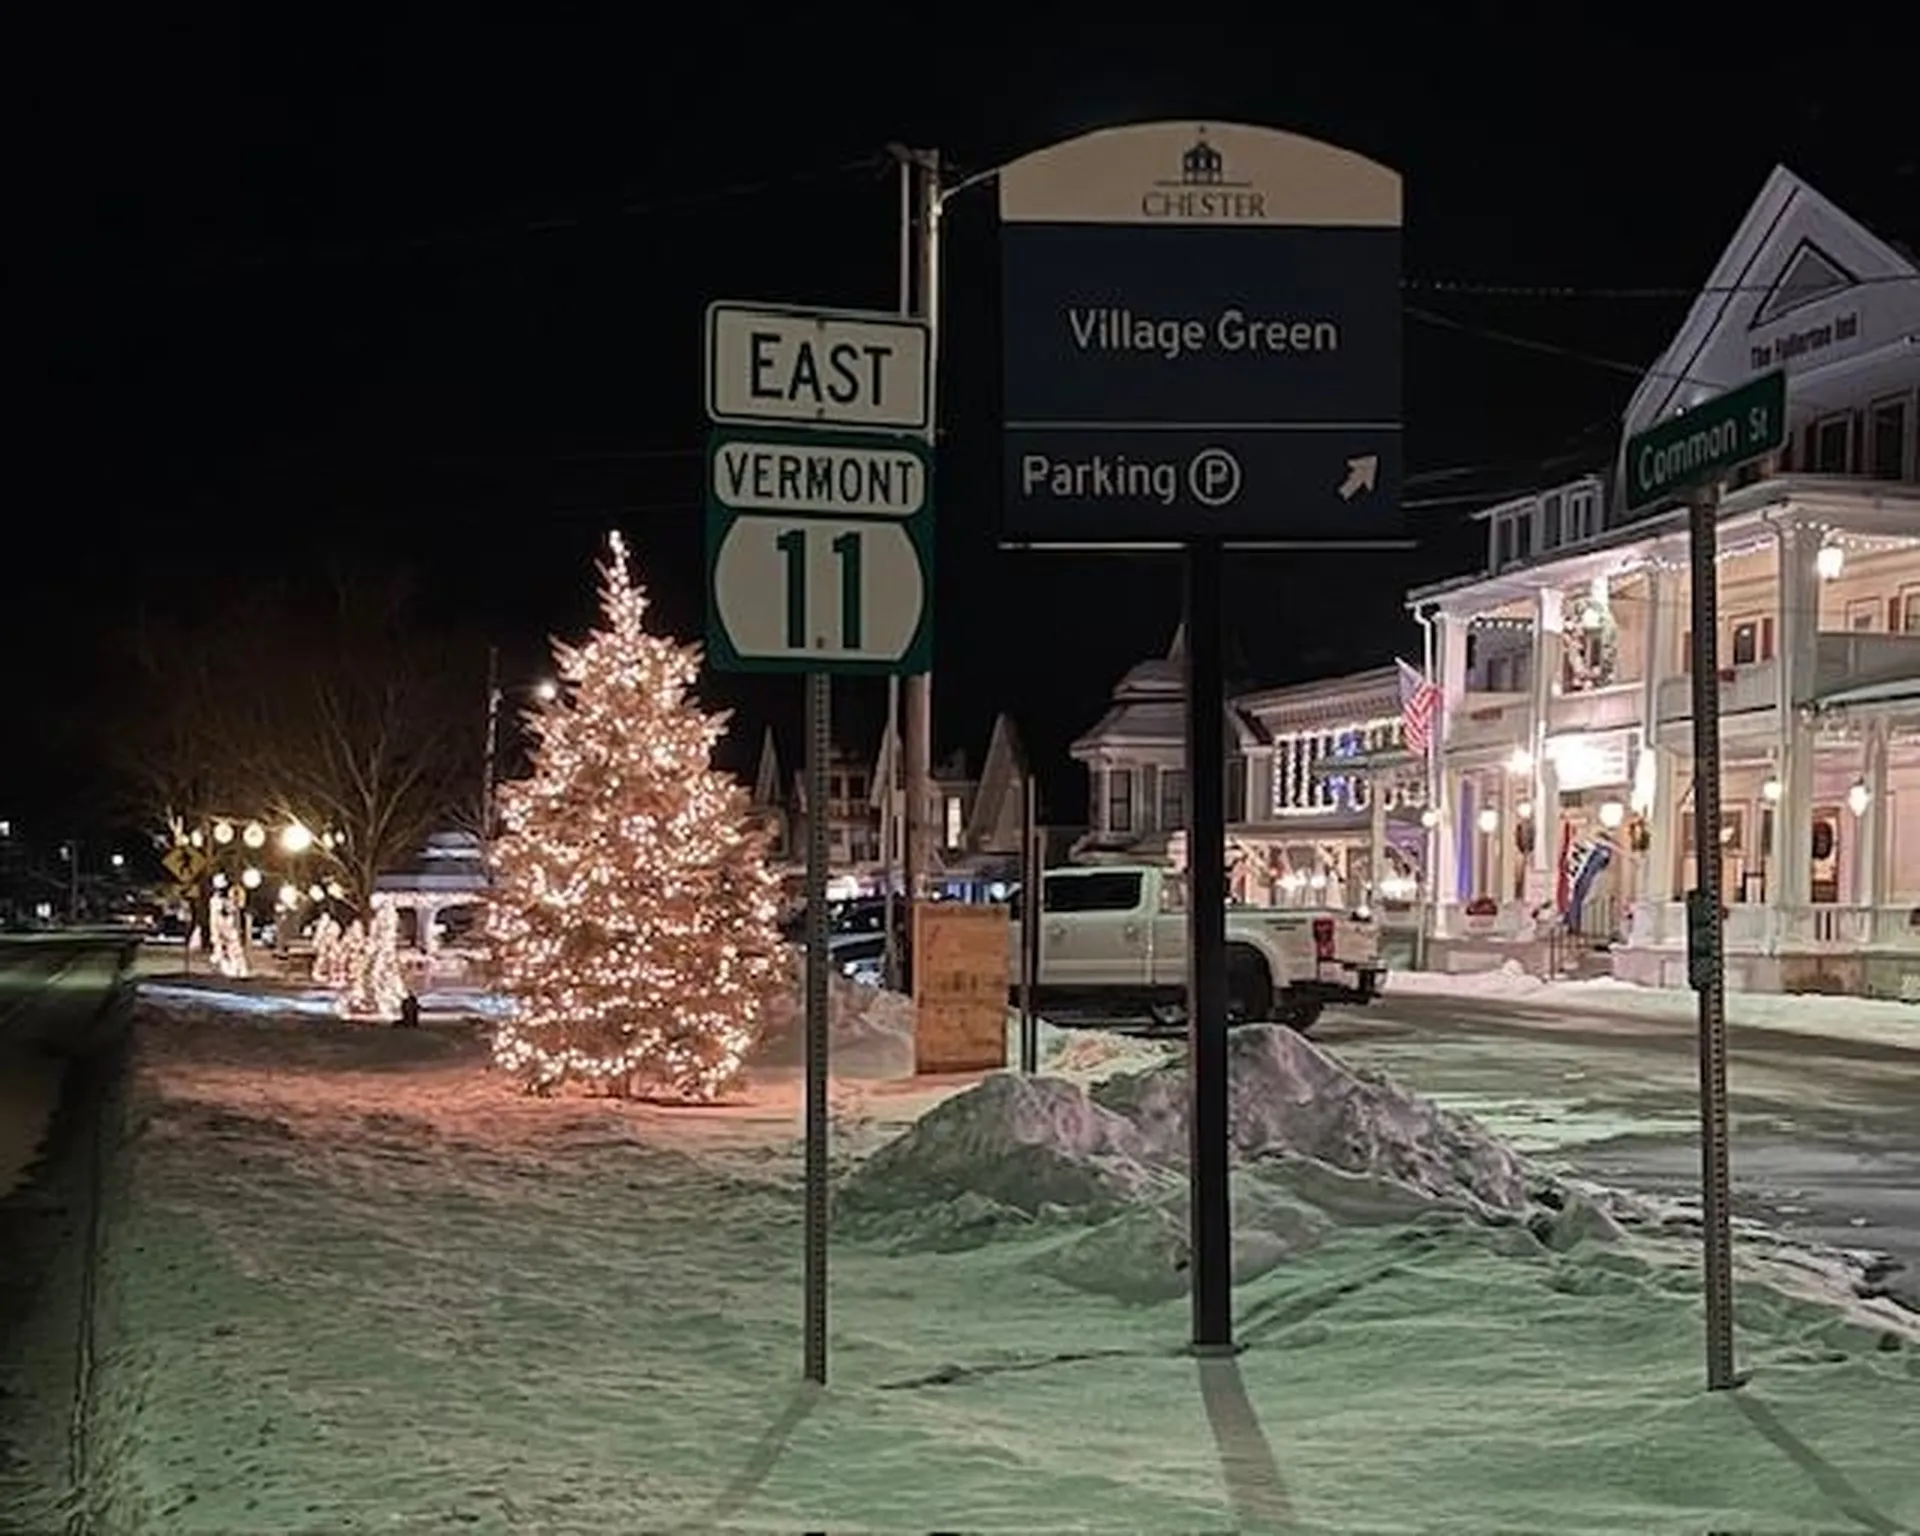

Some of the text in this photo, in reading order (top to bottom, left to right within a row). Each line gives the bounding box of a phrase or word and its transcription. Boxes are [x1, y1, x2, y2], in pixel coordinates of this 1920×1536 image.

[1142, 191, 1269, 217] CHESTER
[1069, 309, 1338, 359] Village Green
[750, 332, 893, 406] EAST
[1638, 406, 1769, 492] Common St
[725, 451, 914, 505] VERMONT
[1022, 455, 1177, 505] Parking
[776, 529, 862, 649] 11
